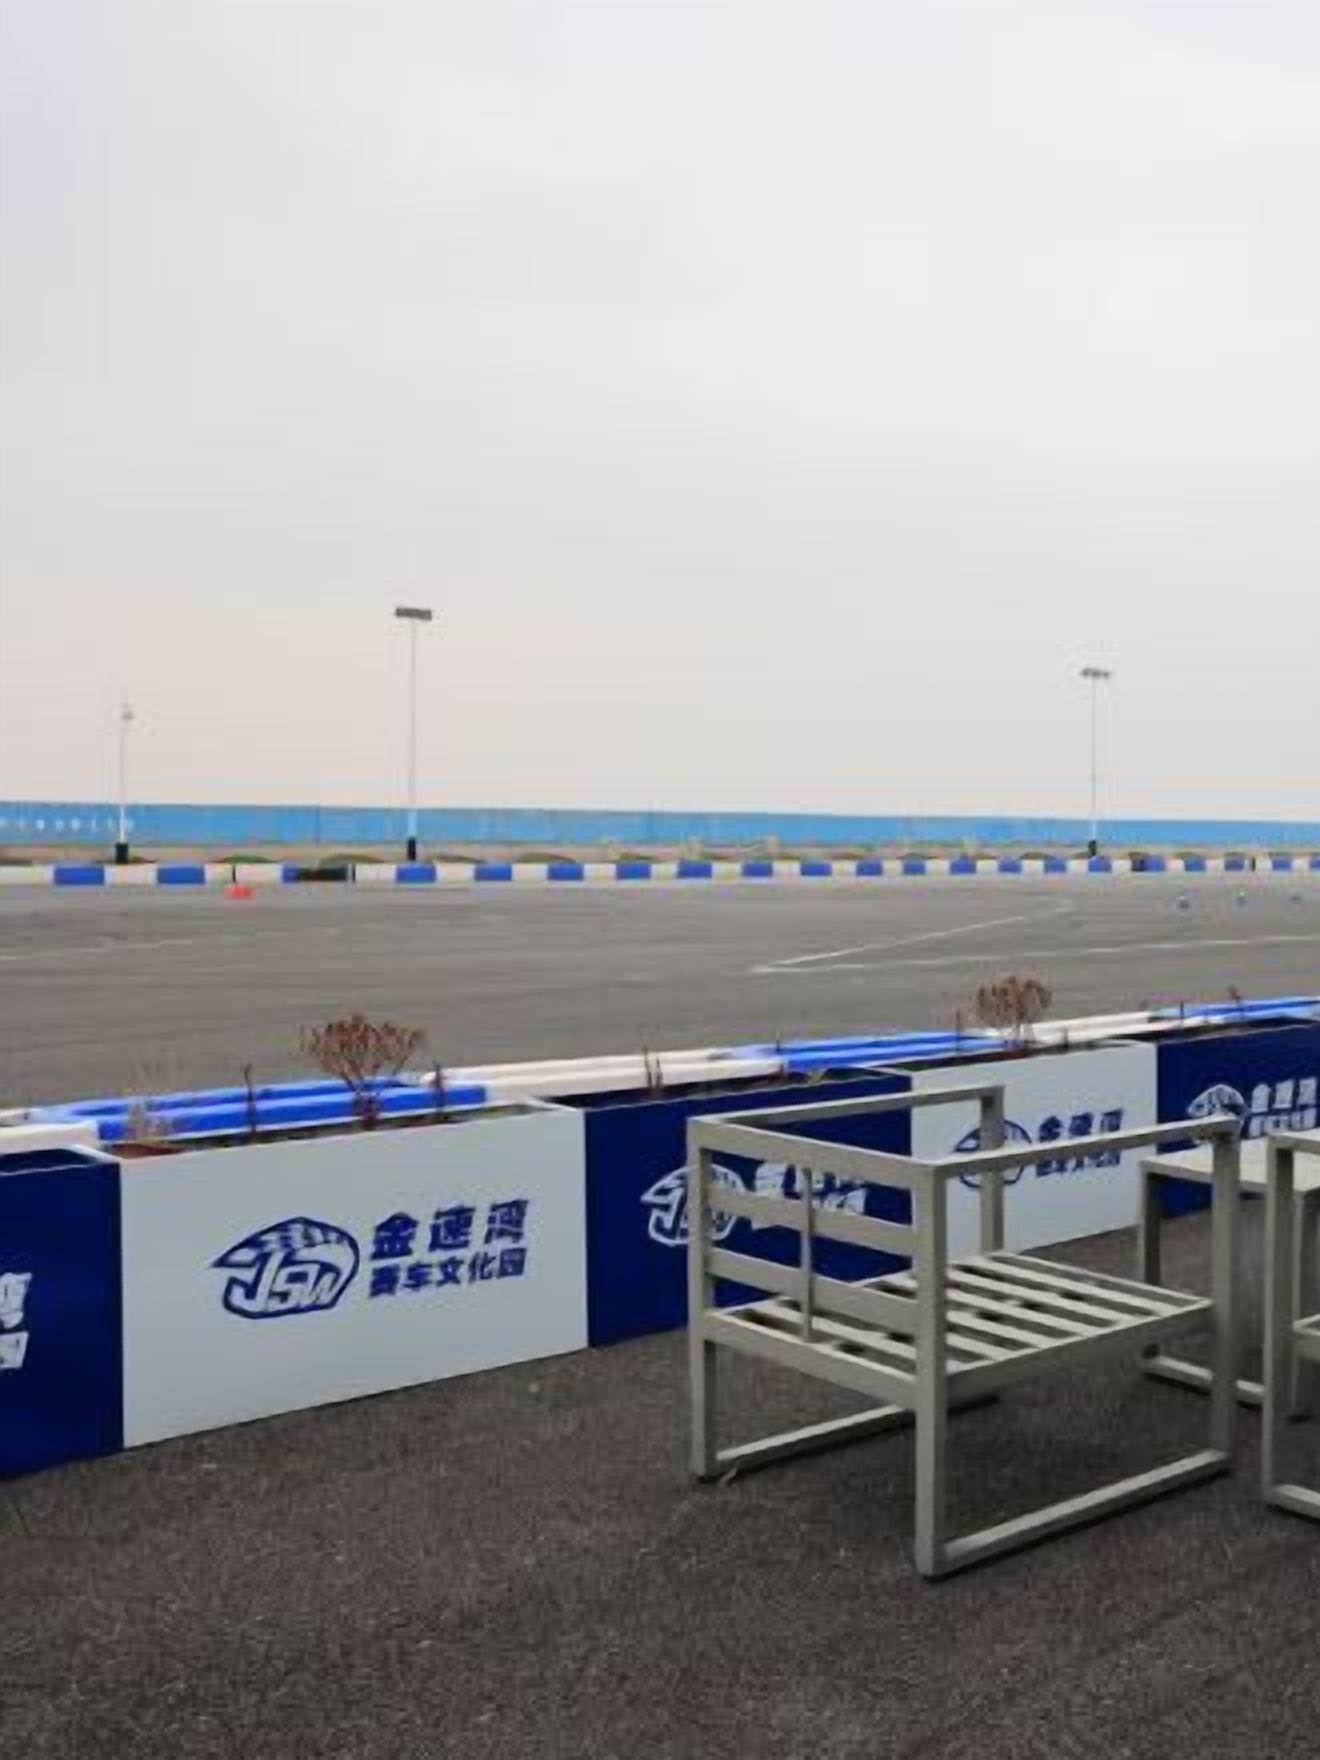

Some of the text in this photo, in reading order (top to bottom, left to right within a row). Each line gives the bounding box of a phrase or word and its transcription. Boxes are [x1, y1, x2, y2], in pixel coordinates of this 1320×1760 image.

[370, 1200, 528, 1260] 金速湾
[369, 1248, 527, 1298] 赛车文化园
